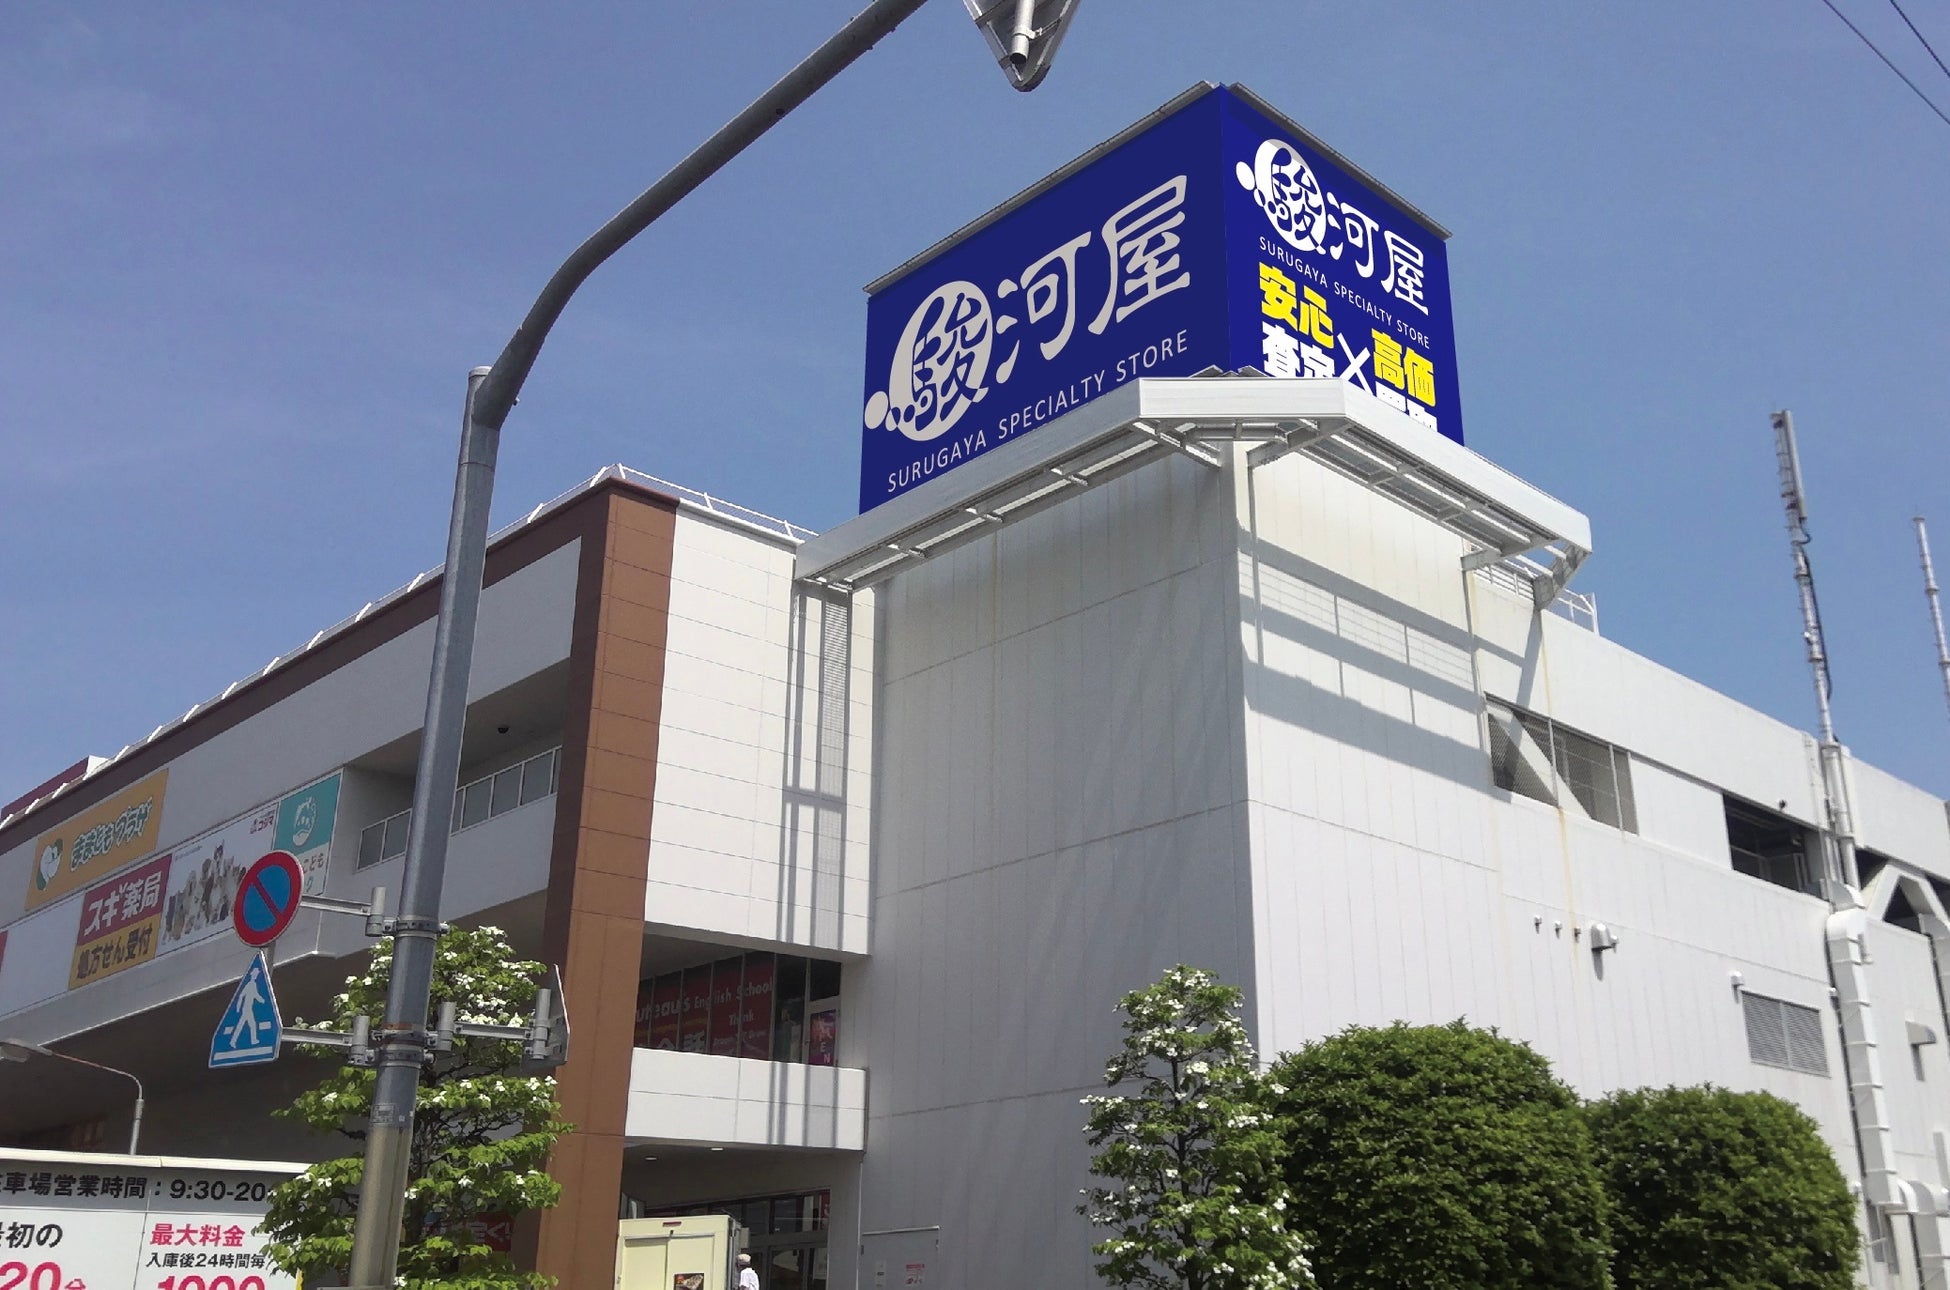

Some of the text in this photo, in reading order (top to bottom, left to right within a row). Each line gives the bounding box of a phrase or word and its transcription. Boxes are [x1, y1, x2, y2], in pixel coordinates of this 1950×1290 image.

[1236, 138, 1429, 316] 駿河屋
[864, 175, 1190, 441] 駿河屋
[1258, 262, 1335, 349] 安心
[1259, 236, 1430, 350] SURUGAYA SPECIALTY STORE
[1371, 328, 1436, 407] 高価
[888, 329, 1188, 493] SURUGAYA SPECIALTY STORE
[84, 871, 162, 937] スギ薬局
[0, 1221, 63, 1249] 初の
[146, 1252, 266, 1270] 入庫後24時間毎
[150, 1223, 245, 1248] 最大料金
